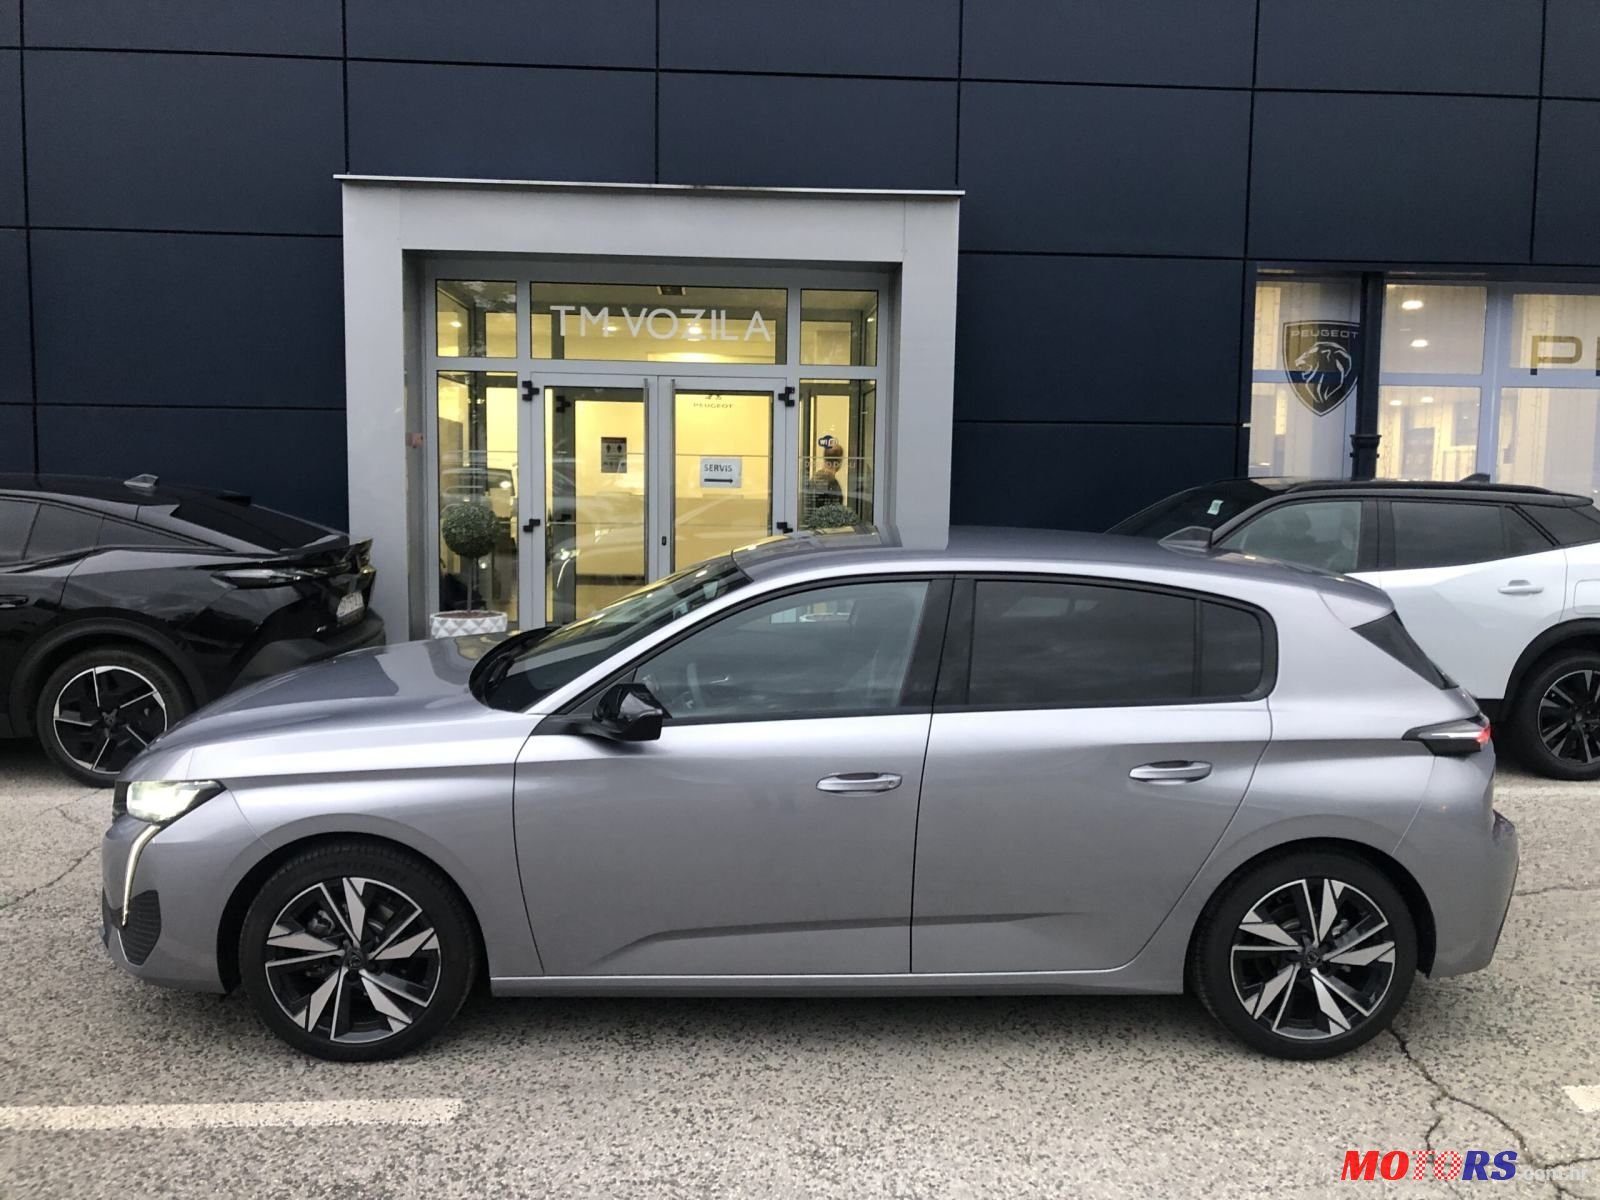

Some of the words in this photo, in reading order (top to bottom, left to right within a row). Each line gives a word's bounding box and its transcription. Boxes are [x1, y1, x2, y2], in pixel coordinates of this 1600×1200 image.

[550, 305, 609, 337] TM
[622, 307, 771, 342] VOZILA
[1289, 329, 1359, 339] PEUGEOT
[704, 463, 733, 473] SERVIS
